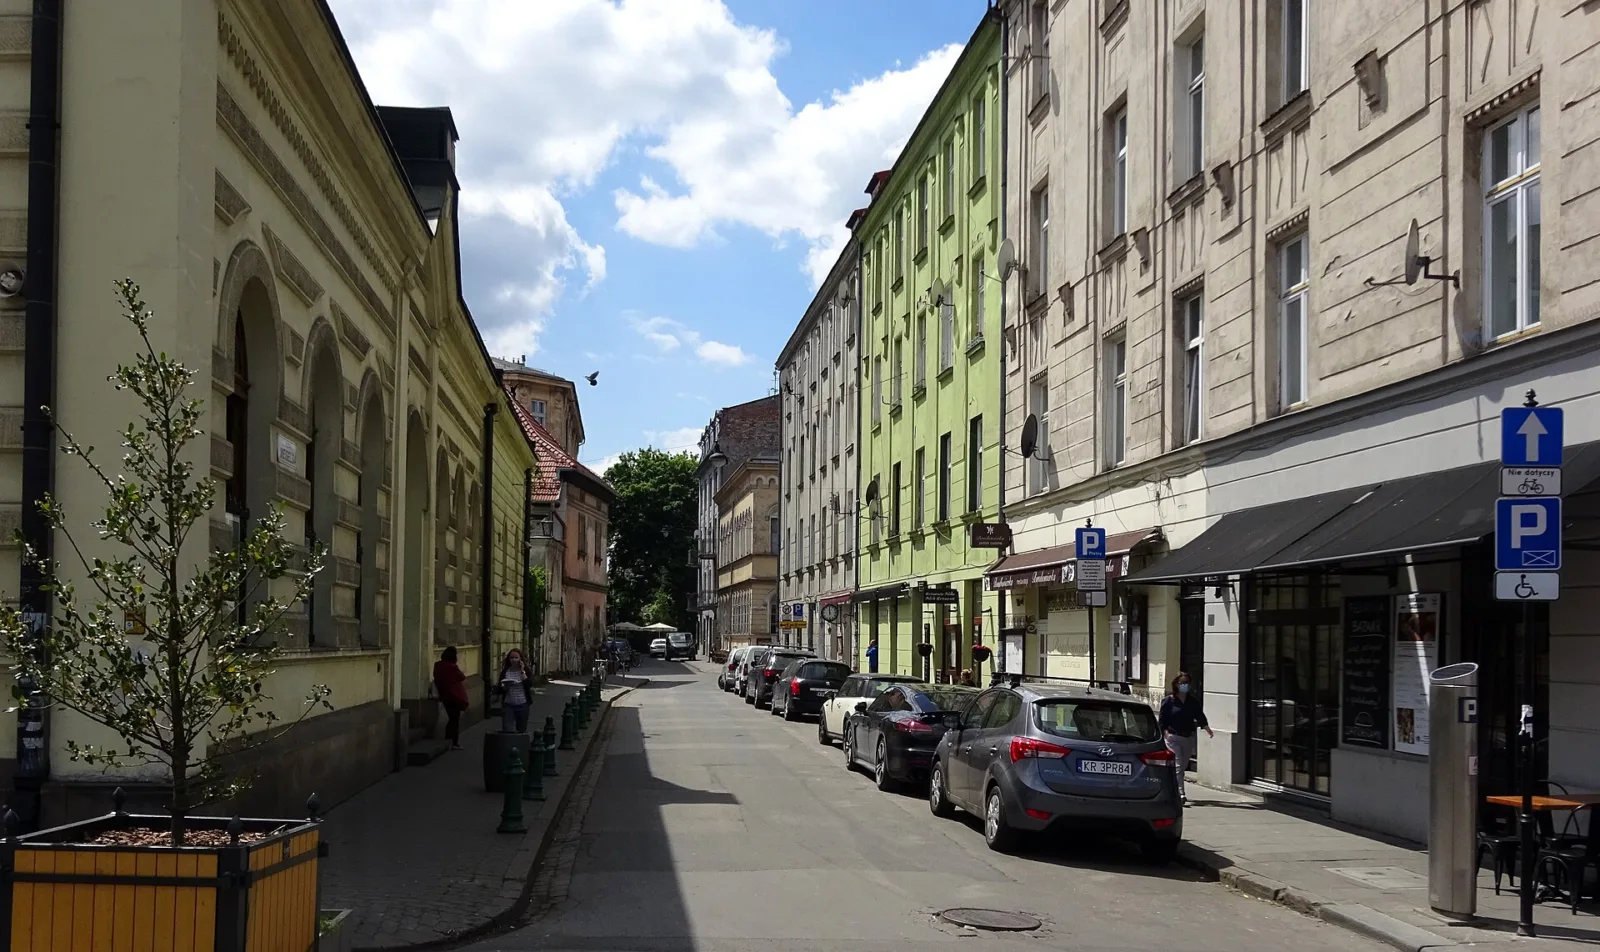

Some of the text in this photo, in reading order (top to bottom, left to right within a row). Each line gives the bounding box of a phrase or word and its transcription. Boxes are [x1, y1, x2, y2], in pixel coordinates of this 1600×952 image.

[1508, 468, 1555, 478] Nie dotyczy
[1511, 504, 1547, 549] P
[1082, 532, 1099, 555] P
[1083, 761, 1097, 772] KR
[1100, 762, 1130, 774] 3PR84
